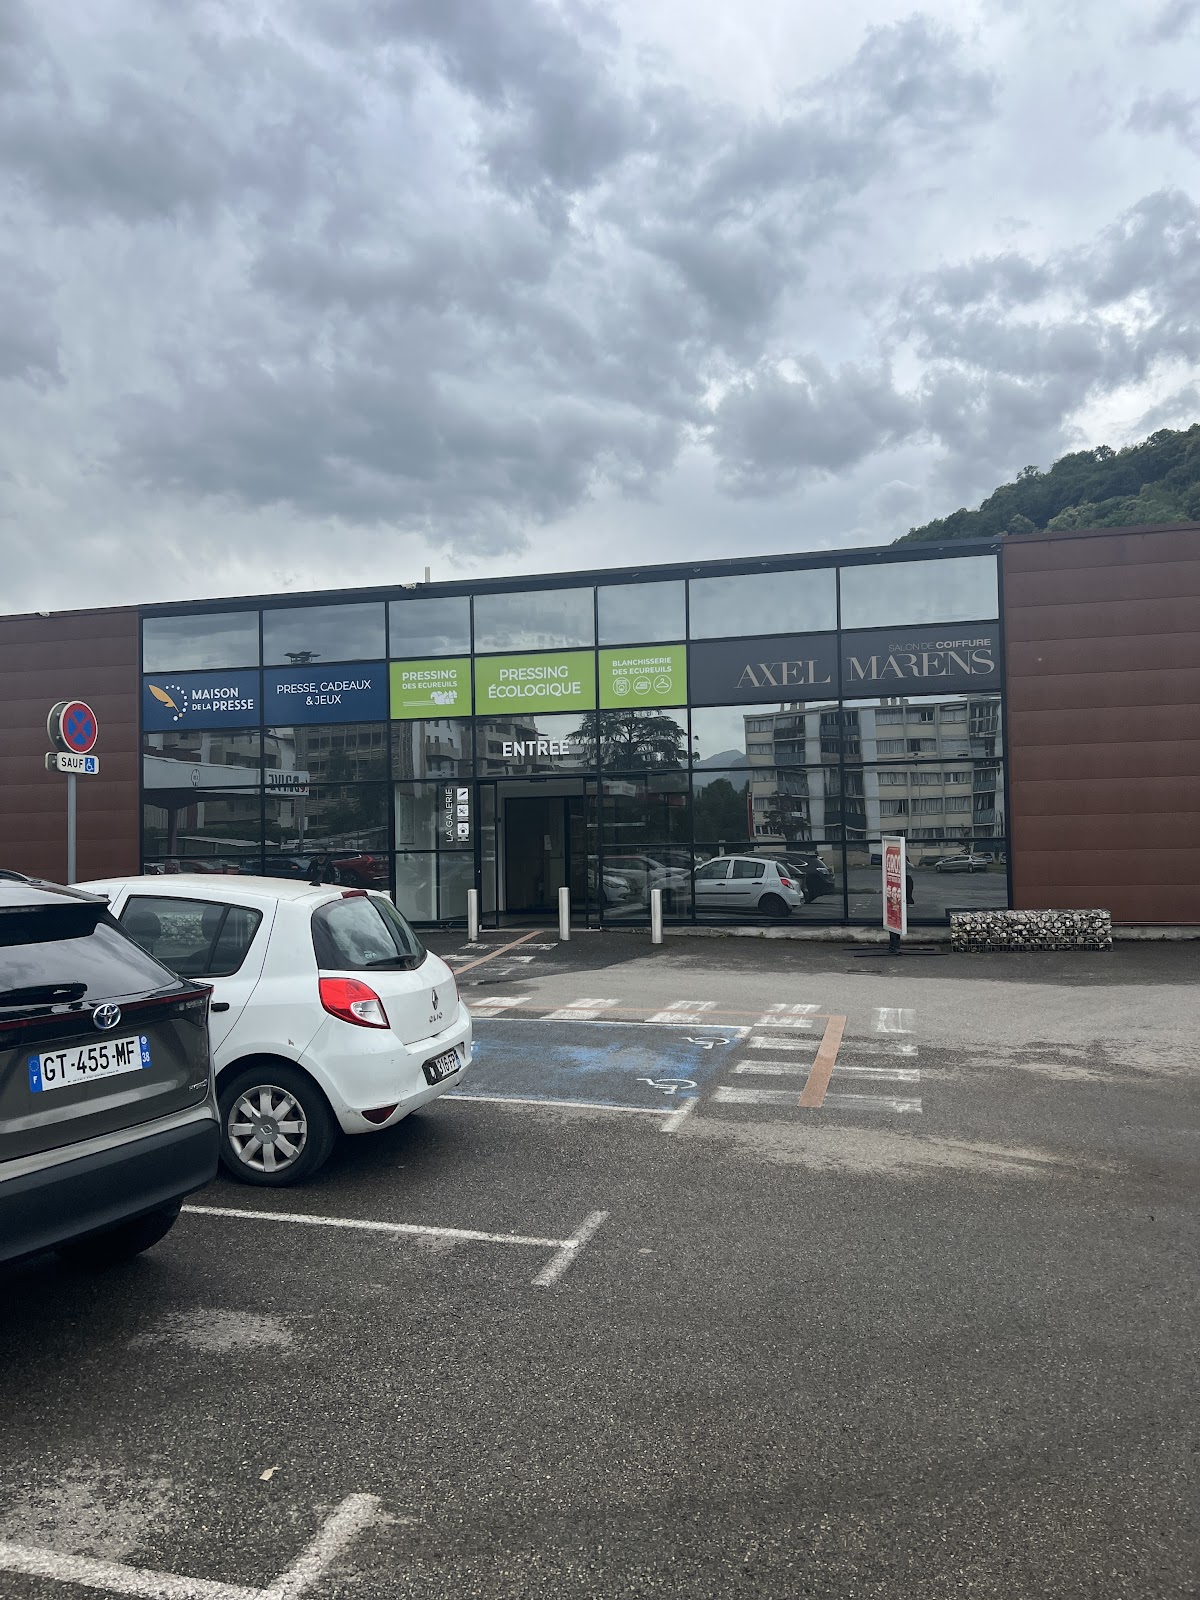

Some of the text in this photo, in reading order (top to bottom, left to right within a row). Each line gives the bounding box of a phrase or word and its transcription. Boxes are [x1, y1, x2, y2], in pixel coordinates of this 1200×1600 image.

[888, 638, 991, 653] SALON DE COIFFURE
[612, 657, 672, 667] BLANCHISSERIE
[402, 669, 457, 681] PRESSING
[499, 665, 569, 682] PRESSING
[612, 666, 672, 676] DES ECUREUILS
[734, 649, 995, 689] AXEL MARENS
[277, 680, 371, 695] PRESSE, CADEAUX
[402, 681, 458, 690] DES ECUREUILS
[488, 682, 581, 699] ÉCOLOGIQUE
[191, 688, 239, 700] MAISON
[305, 694, 341, 706] & JEUX
[192, 703, 202, 711] DE
[212, 699, 254, 712] PRESSE
[502, 737, 570, 757] ENTRÉE
[61, 757, 84, 769] SAUF
[445, 788, 454, 842] LA GALERIE
[429, 1011, 443, 1023] CLIO
[33, 1076, 38, 1085] F
[43, 1040, 136, 1082] GT-455-MF
[142, 1051, 151, 1063] 38
